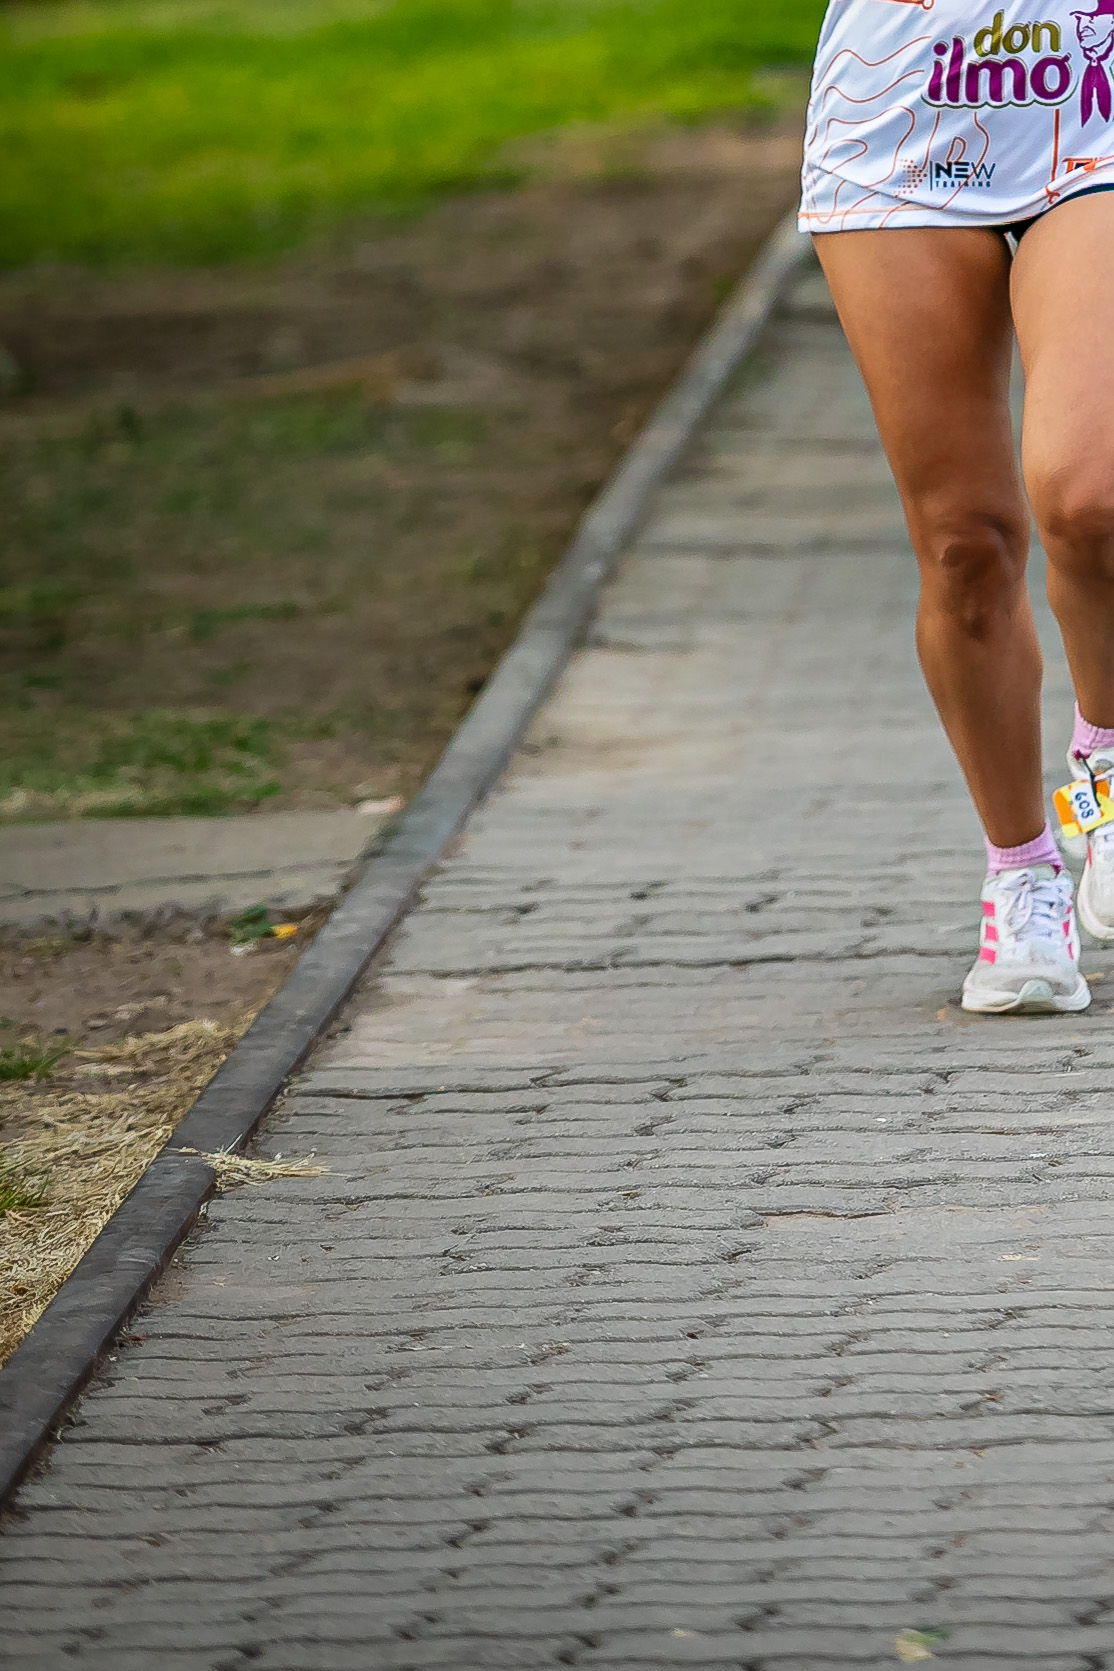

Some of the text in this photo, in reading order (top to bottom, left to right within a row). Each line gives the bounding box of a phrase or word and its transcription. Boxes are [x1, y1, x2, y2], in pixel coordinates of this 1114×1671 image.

[974, 9, 1061, 57] don
[928, 36, 1072, 103] ilmo
[935, 161, 996, 179] NEW
[1075, 792, 1094, 819] 608
